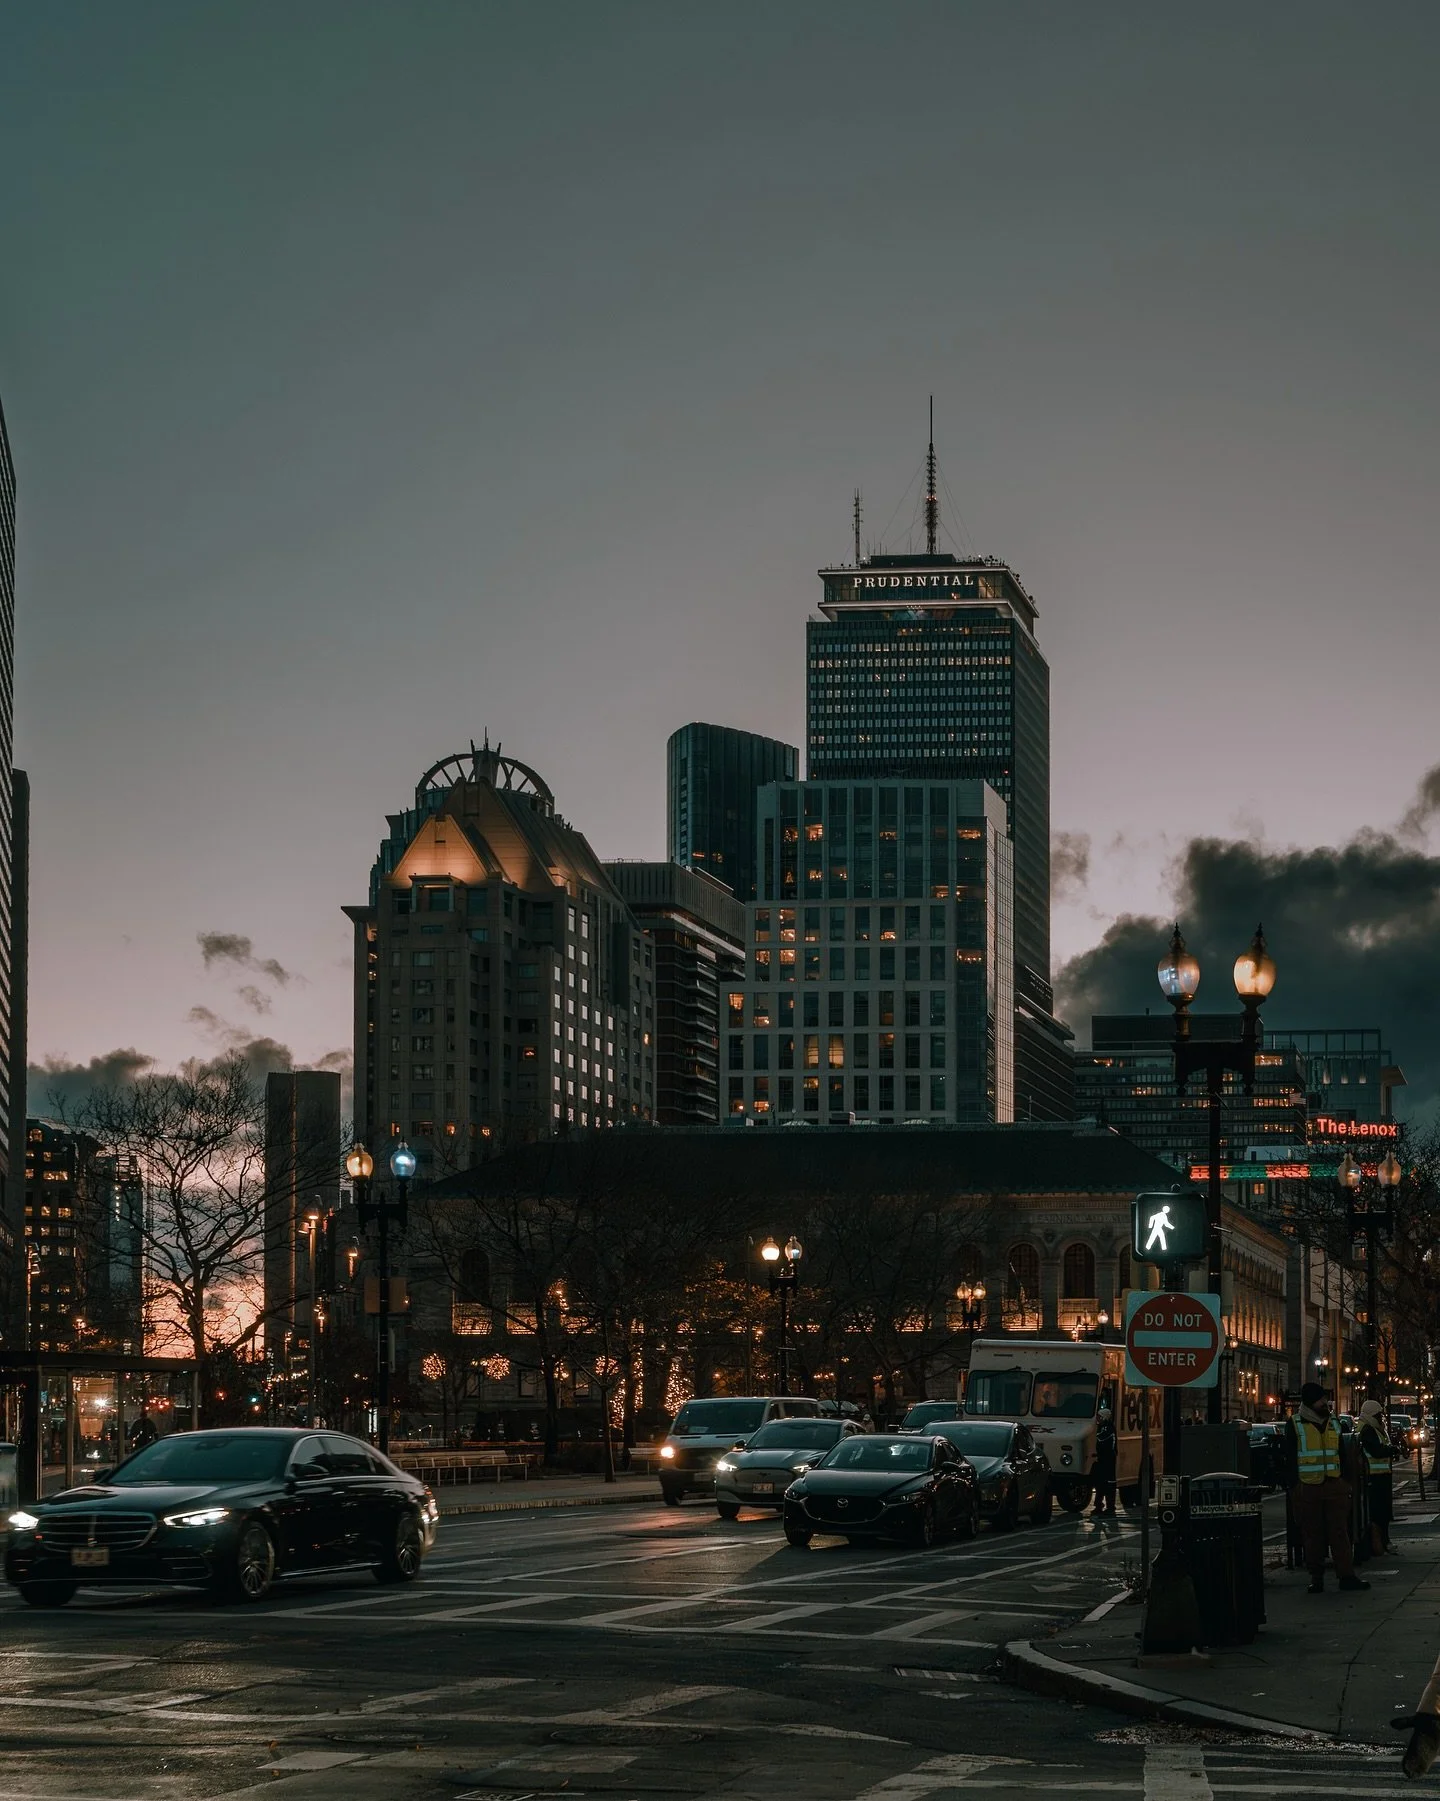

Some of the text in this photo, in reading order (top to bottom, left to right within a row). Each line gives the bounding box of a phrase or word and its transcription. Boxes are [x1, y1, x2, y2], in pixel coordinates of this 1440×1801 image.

[853, 575, 974, 588] PRUDENTIAL
[1317, 1118, 1397, 1136] The Lenox
[1144, 1312, 1202, 1328] DO NOT
[1147, 1352, 1196, 1367] ENTER
